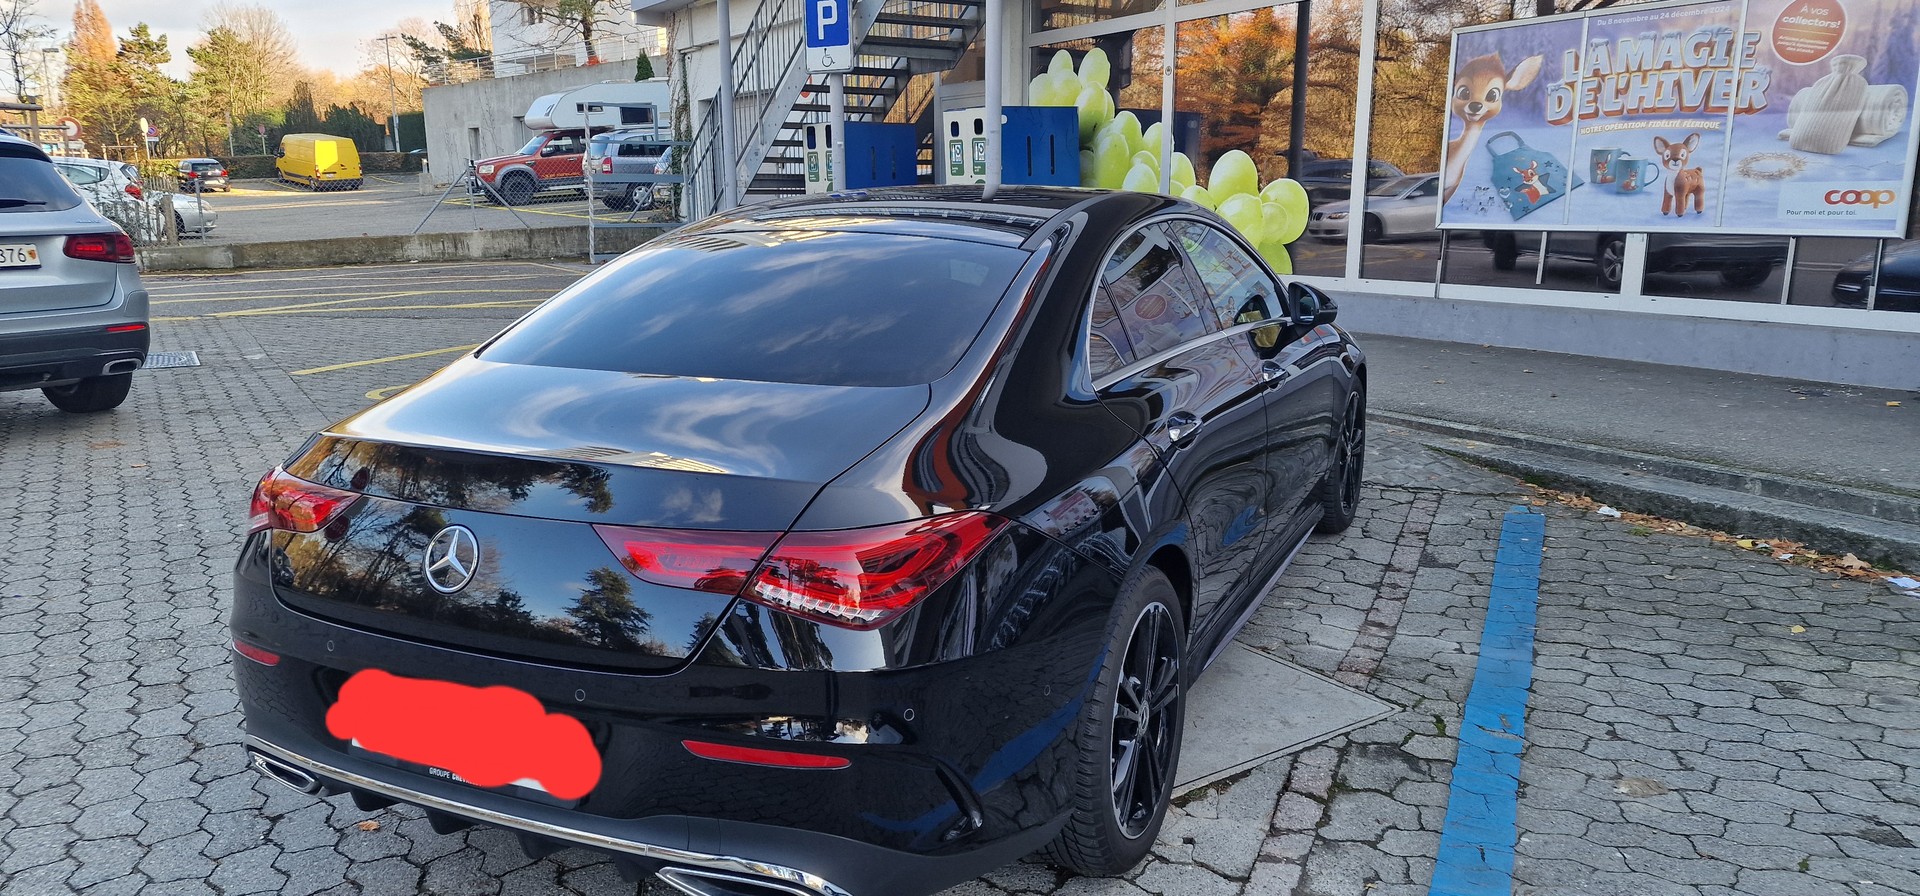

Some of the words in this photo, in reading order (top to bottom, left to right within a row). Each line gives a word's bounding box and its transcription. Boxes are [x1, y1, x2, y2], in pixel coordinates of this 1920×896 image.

[817, 0, 838, 40] P
[1613, 15, 1649, 24] novembre
[1670, 8, 1708, 18] décembre
[1710, 5, 1731, 13] 2024
[1811, 7, 1830, 16] vos
[1782, 16, 1841, 29] collectors!
[1563, 38, 1613, 83] LA
[1614, 26, 1763, 75] MAGIE
[1545, 78, 1601, 125] DE
[1601, 66, 1773, 116] L'HIVER
[1580, 125, 1603, 135] NOTRE
[1604, 121, 1647, 131] OPÉRATION
[1648, 119, 1681, 129] FIDÉLITÉ
[1682, 119, 1720, 130] FÉERIQUE
[1824, 189, 1896, 209] coop
[429, 767, 450, 779] GROUPE
